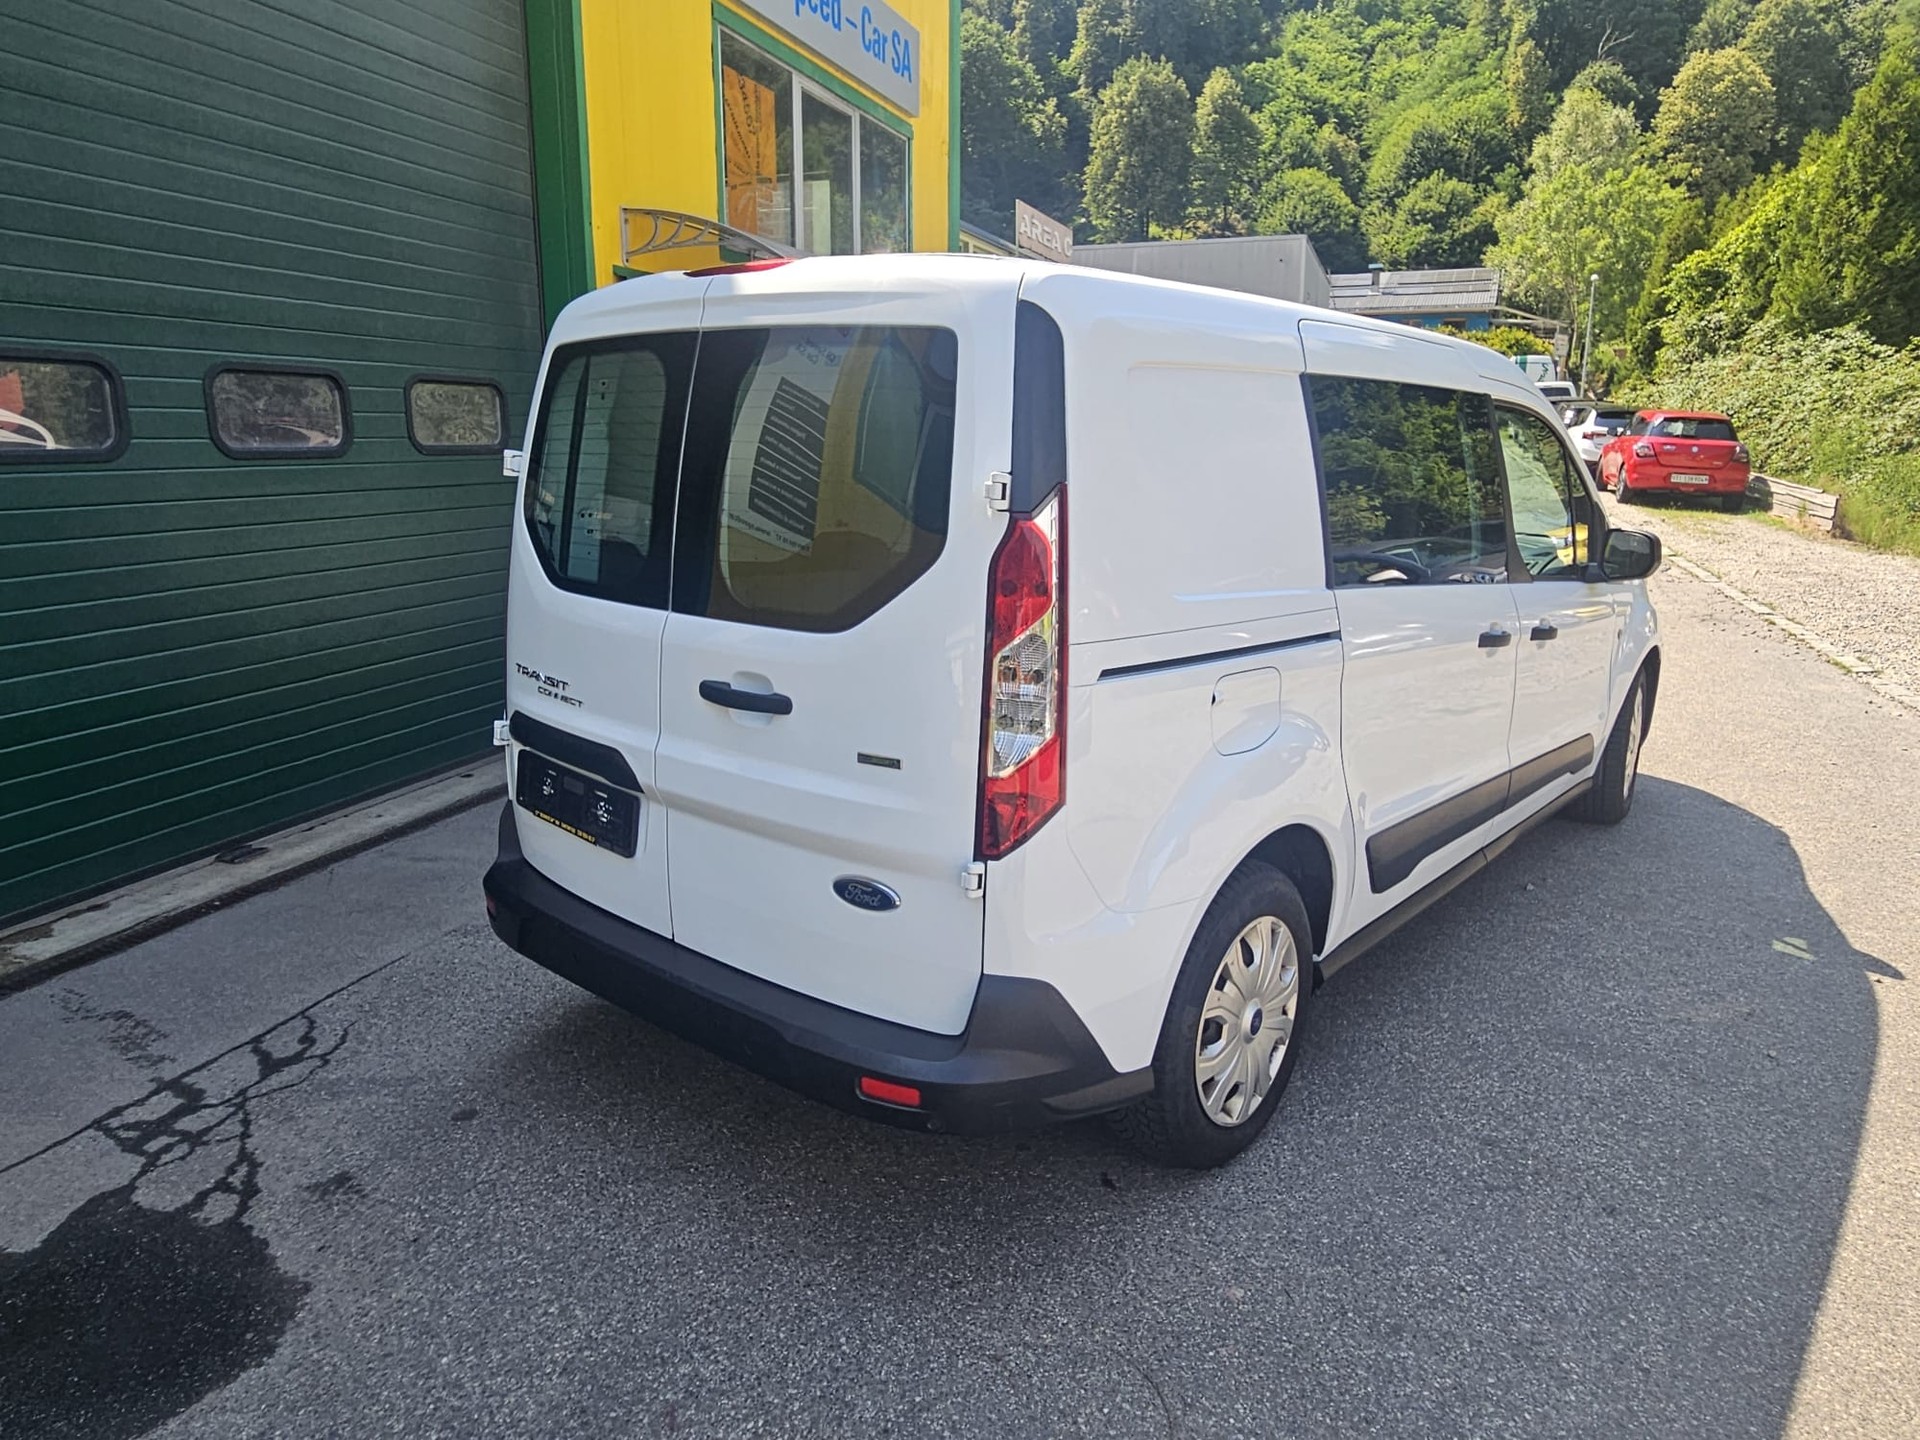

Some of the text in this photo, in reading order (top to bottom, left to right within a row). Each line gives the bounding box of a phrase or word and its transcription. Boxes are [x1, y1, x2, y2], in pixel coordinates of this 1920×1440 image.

[861, 6, 888, 64] Car
[891, 29, 912, 83] SA
[1020, 214, 1062, 253] AREA
[516, 662, 569, 691] TRANSIT
[844, 882, 882, 907] Ford
